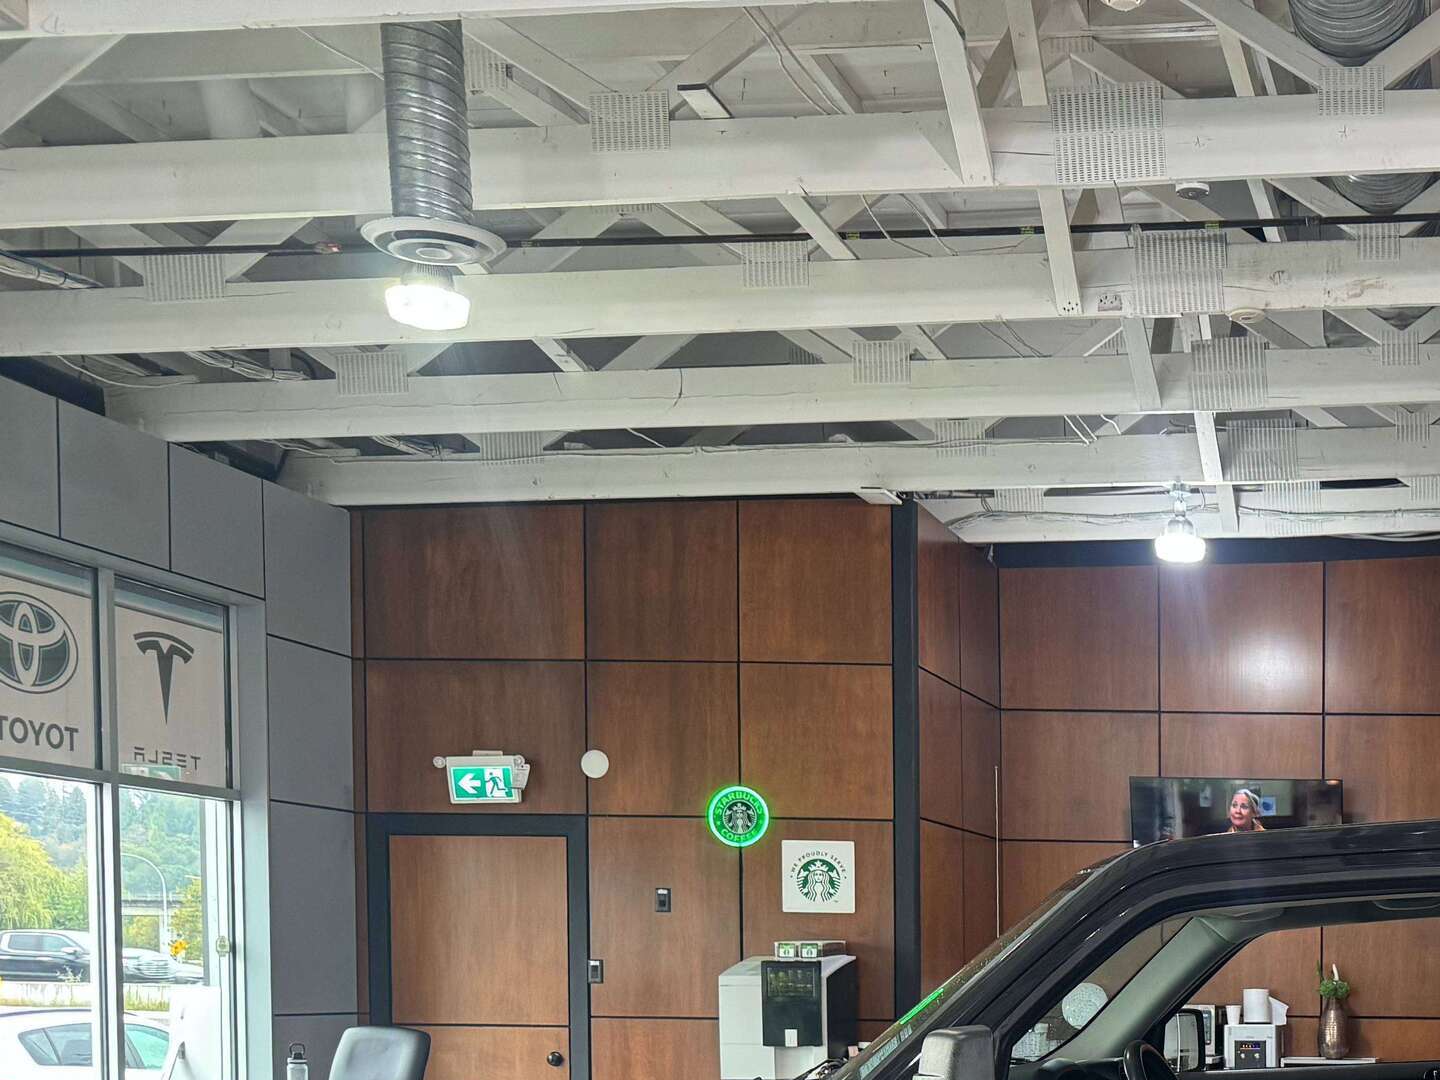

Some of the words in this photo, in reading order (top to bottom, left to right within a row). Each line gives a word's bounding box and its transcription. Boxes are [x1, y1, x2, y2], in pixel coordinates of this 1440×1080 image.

[714, 791, 763, 815] STARBUCKS
[721, 828, 759, 842] COFFEE
[798, 850, 828, 862] PROUDLY
[830, 855, 846, 872] SERVE
